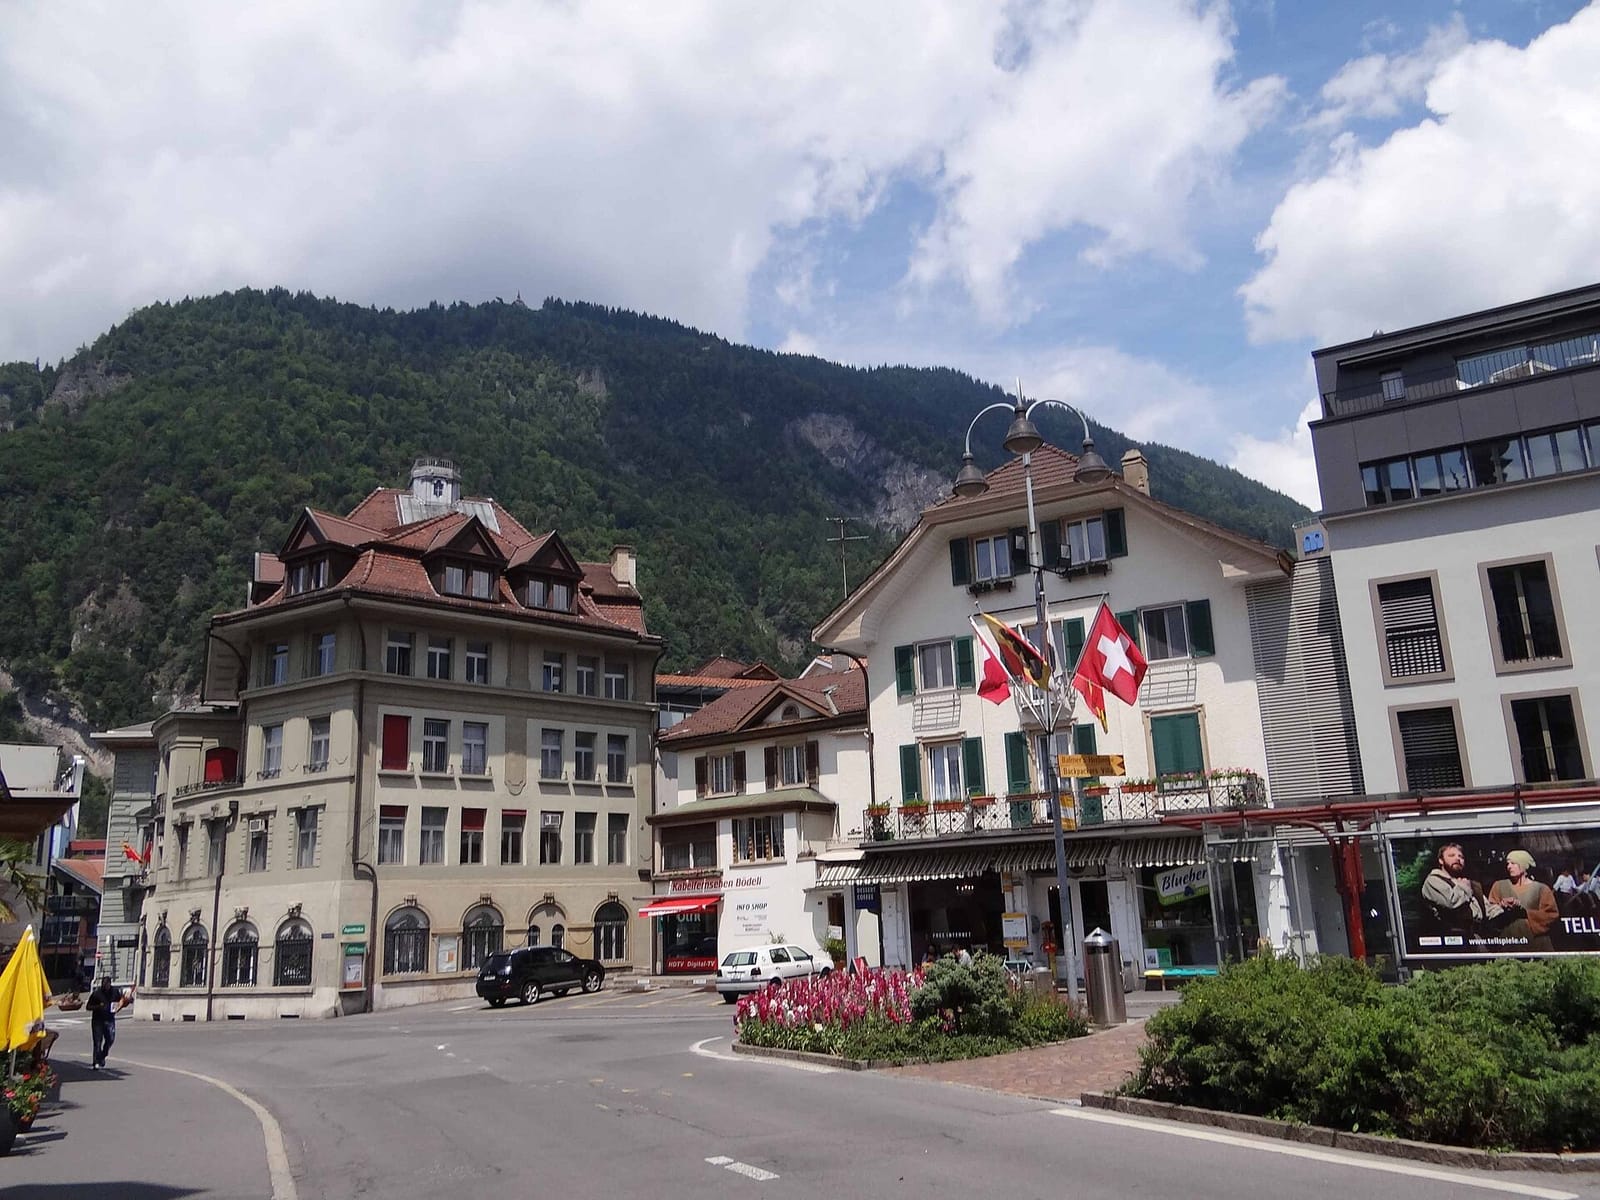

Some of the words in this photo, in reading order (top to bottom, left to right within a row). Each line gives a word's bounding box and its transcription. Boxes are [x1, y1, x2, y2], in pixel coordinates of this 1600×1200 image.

[672, 878, 733, 892] Kabelfernsehen
[1162, 868, 1208, 892] Blueber
[1468, 936, 1529, 946] www.tellspiele.ch
[687, 960, 715, 968] Digital-TV
